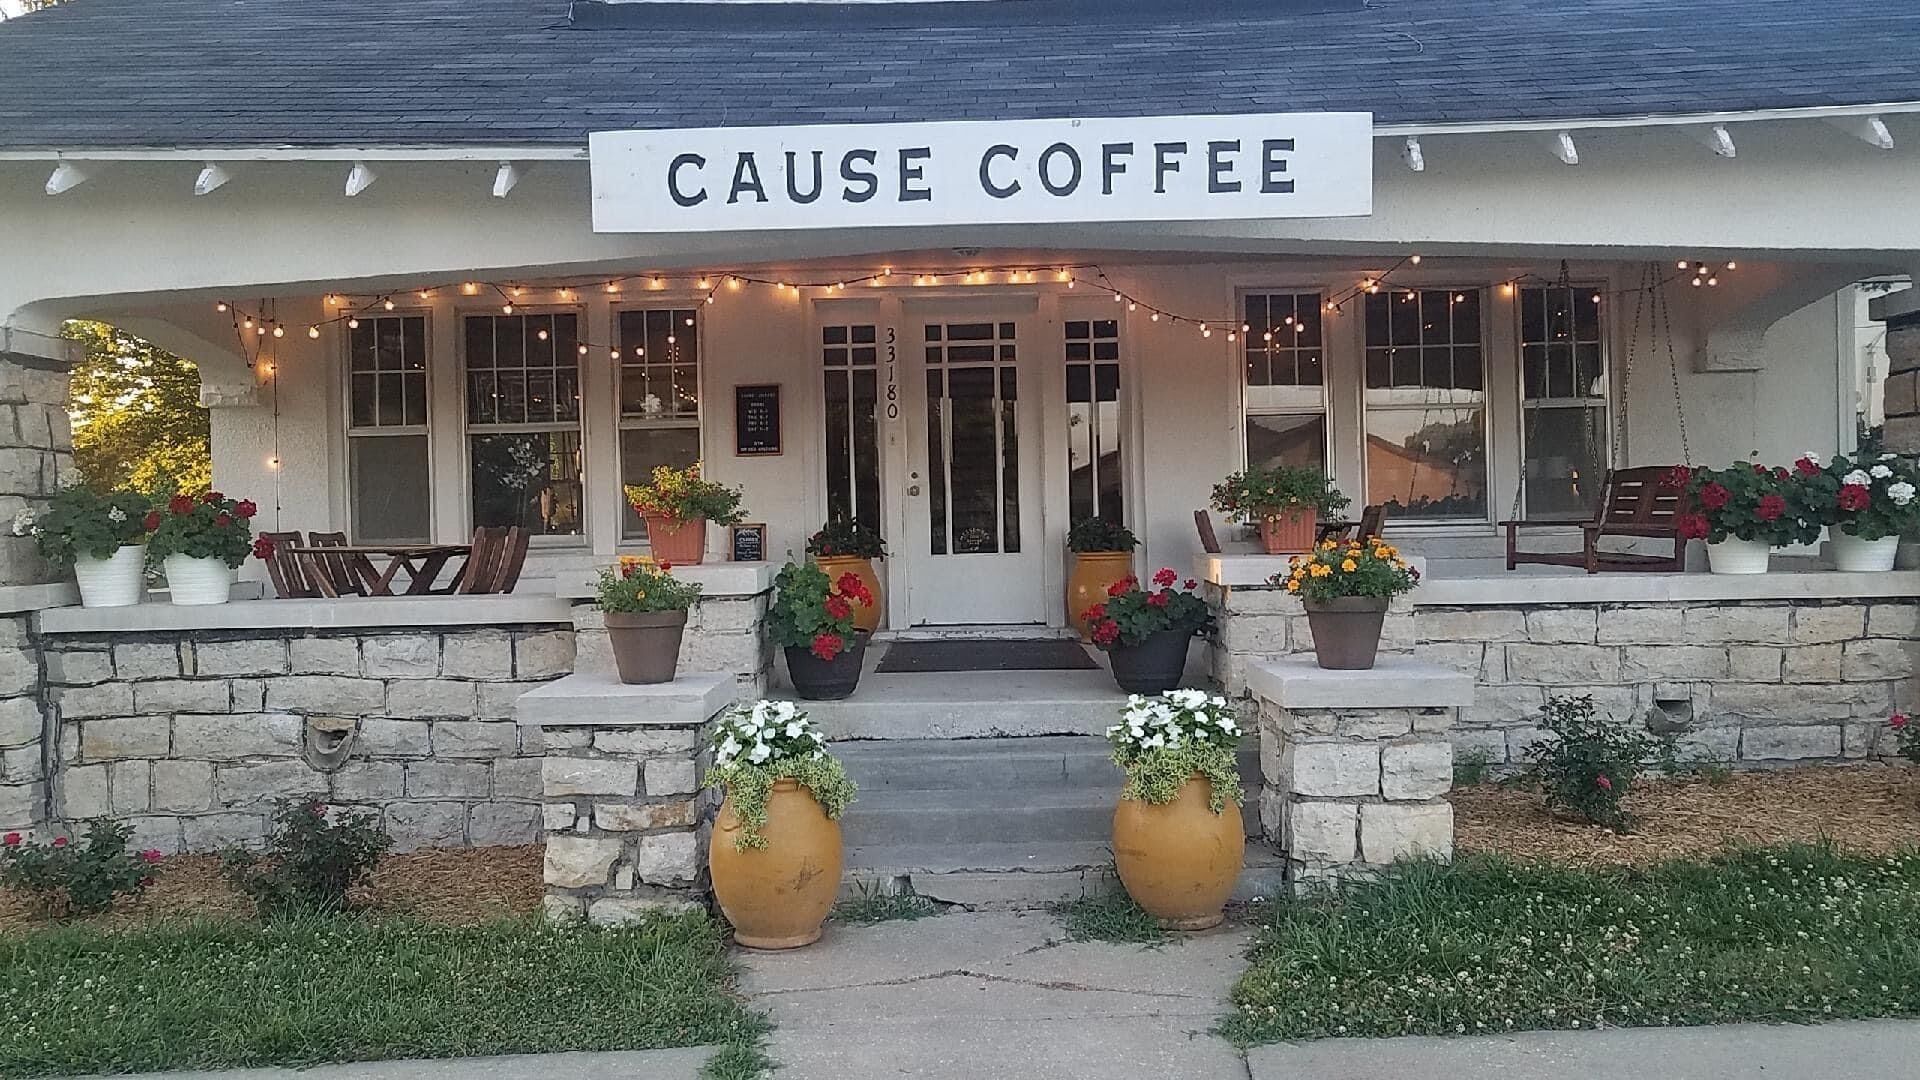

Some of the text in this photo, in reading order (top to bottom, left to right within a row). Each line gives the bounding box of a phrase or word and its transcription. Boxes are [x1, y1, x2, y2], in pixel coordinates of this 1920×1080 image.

[667, 138, 1295, 208] CAUSE COFFEE
[885, 327, 898, 419] 33180
